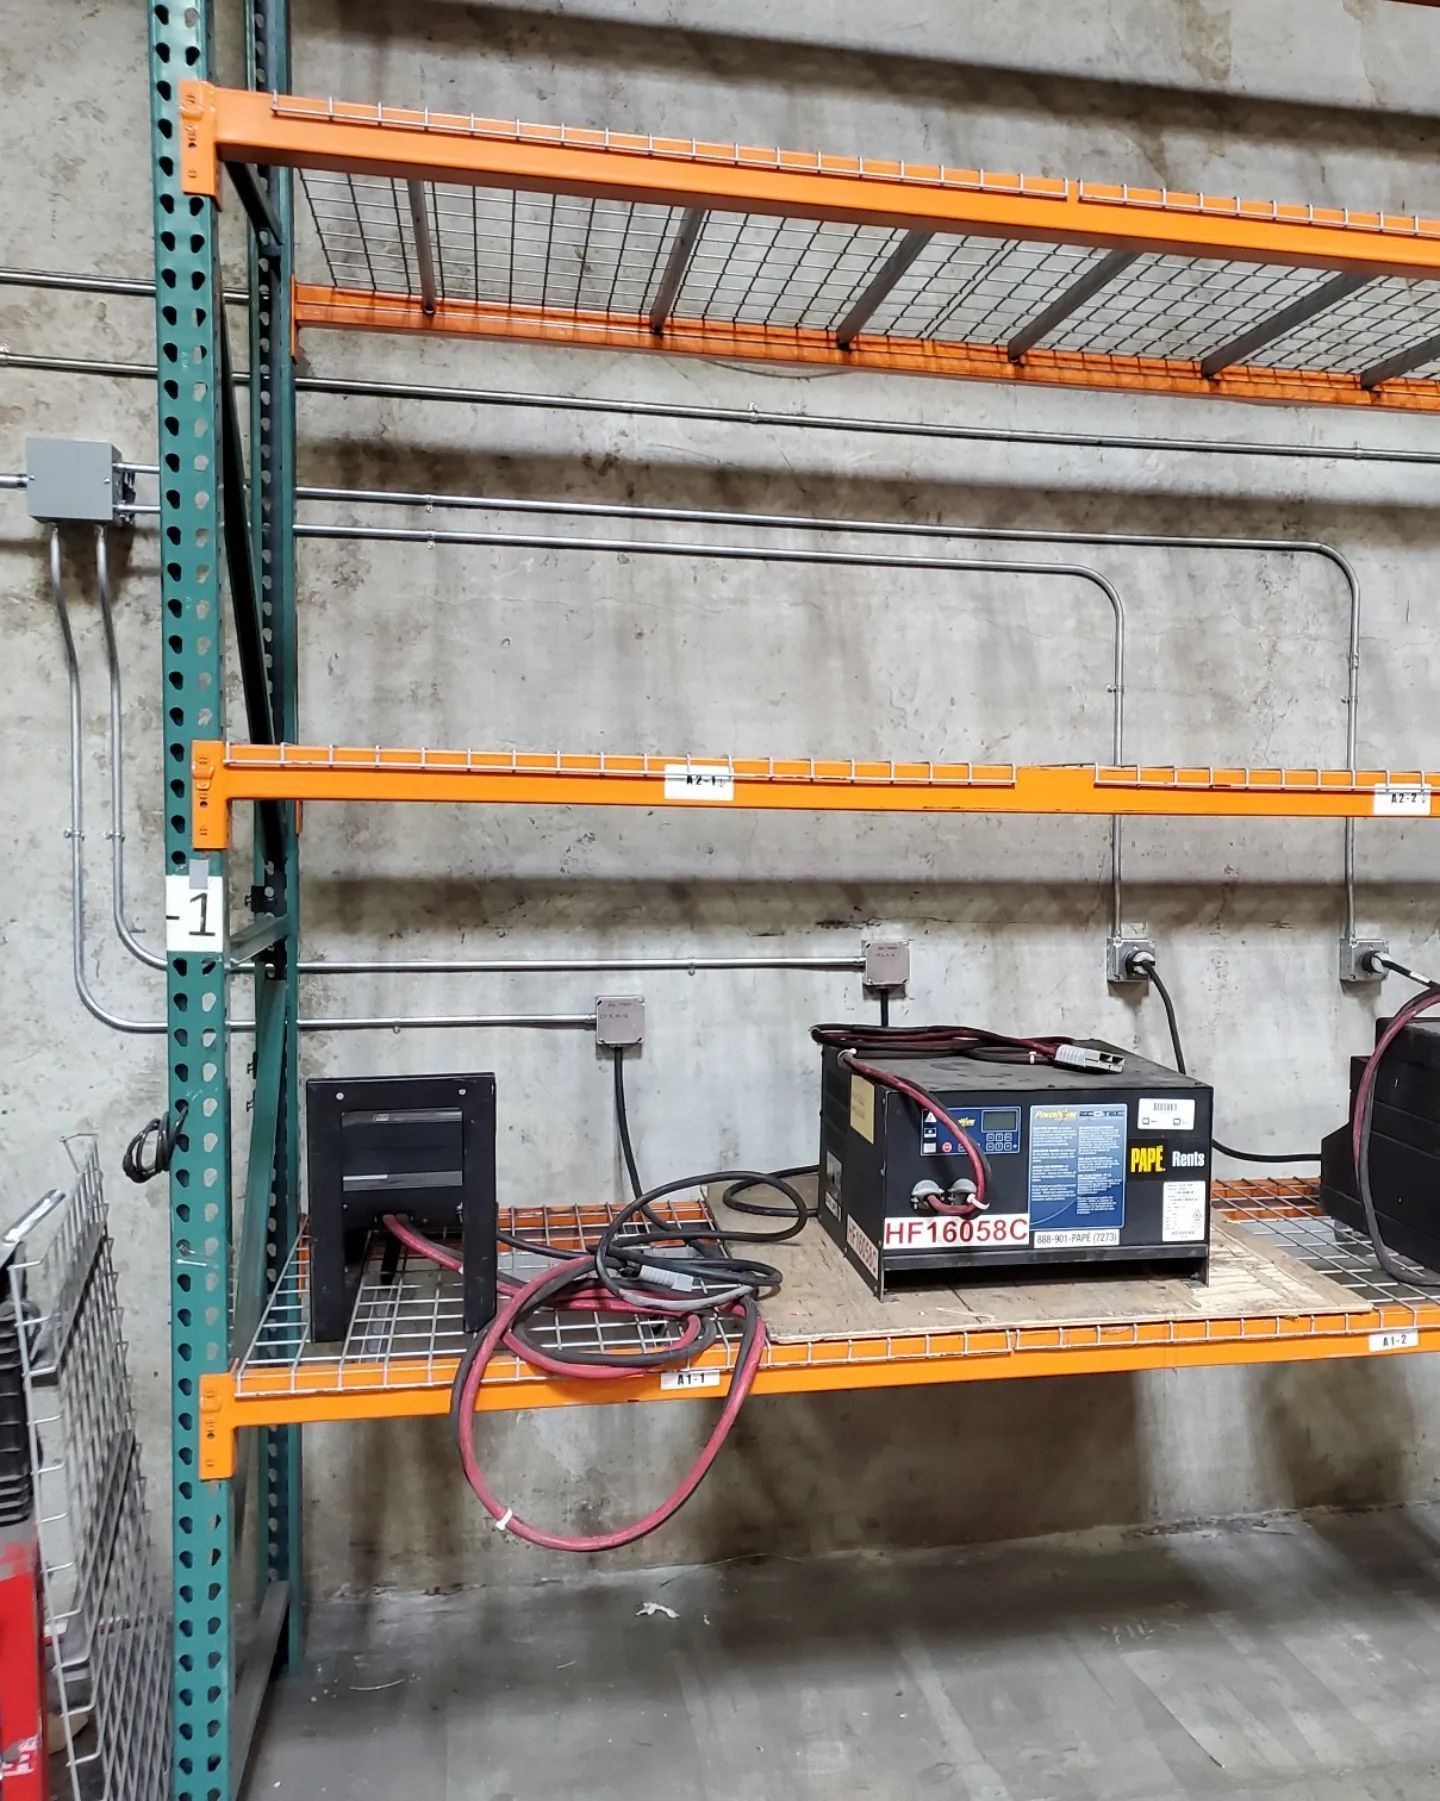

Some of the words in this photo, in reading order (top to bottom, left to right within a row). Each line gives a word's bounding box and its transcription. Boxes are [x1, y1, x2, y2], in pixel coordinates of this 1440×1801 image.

[1391, 793, 1417, 803] A2-2
[1172, 1151, 1205, 1167] Rents
[886, 1218, 1028, 1245] HF16058C
[1093, 1232, 1117, 1243] (7273)
[1383, 1334, 1407, 1346] A1-2
[677, 1372, 705, 1385] A1-1
